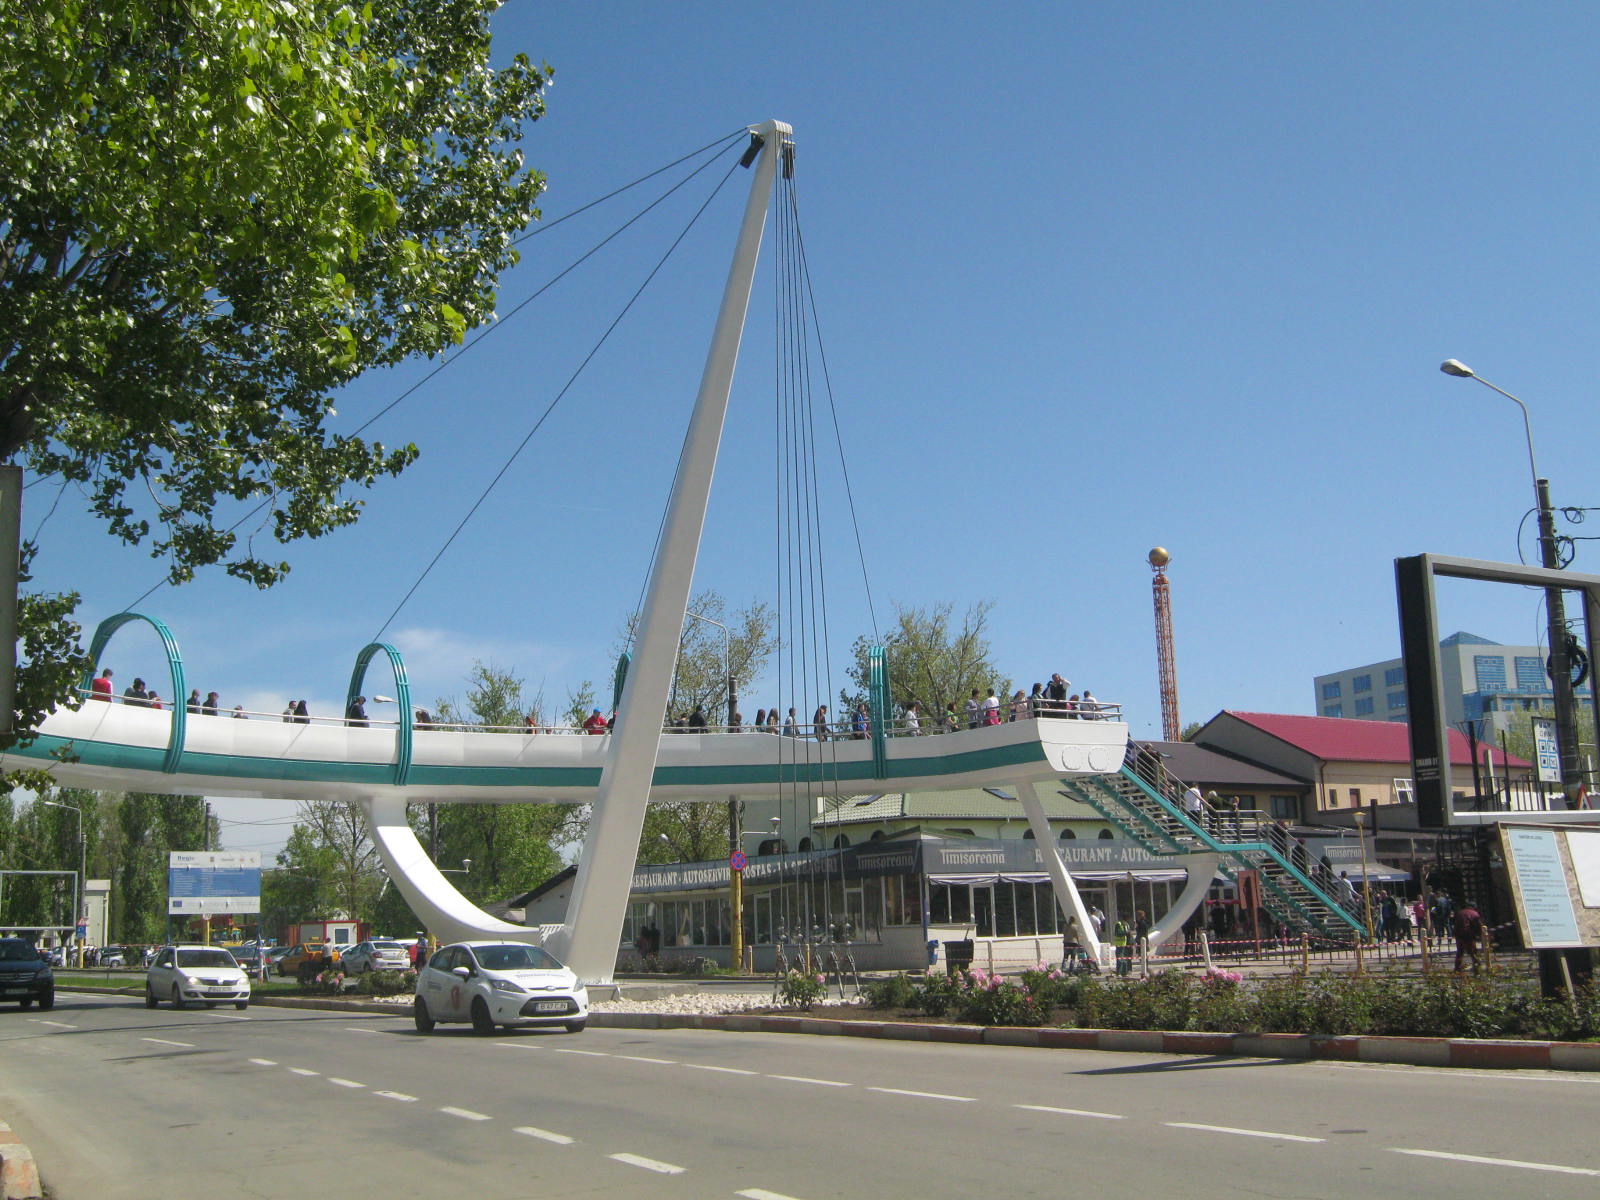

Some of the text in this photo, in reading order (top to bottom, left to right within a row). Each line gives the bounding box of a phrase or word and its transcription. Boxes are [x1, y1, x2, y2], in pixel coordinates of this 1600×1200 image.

[1035, 848, 1111, 863] RTAURANT
[1323, 845, 1362, 858] Timisorean
[682, 867, 731, 884] AUTOSERVIR
